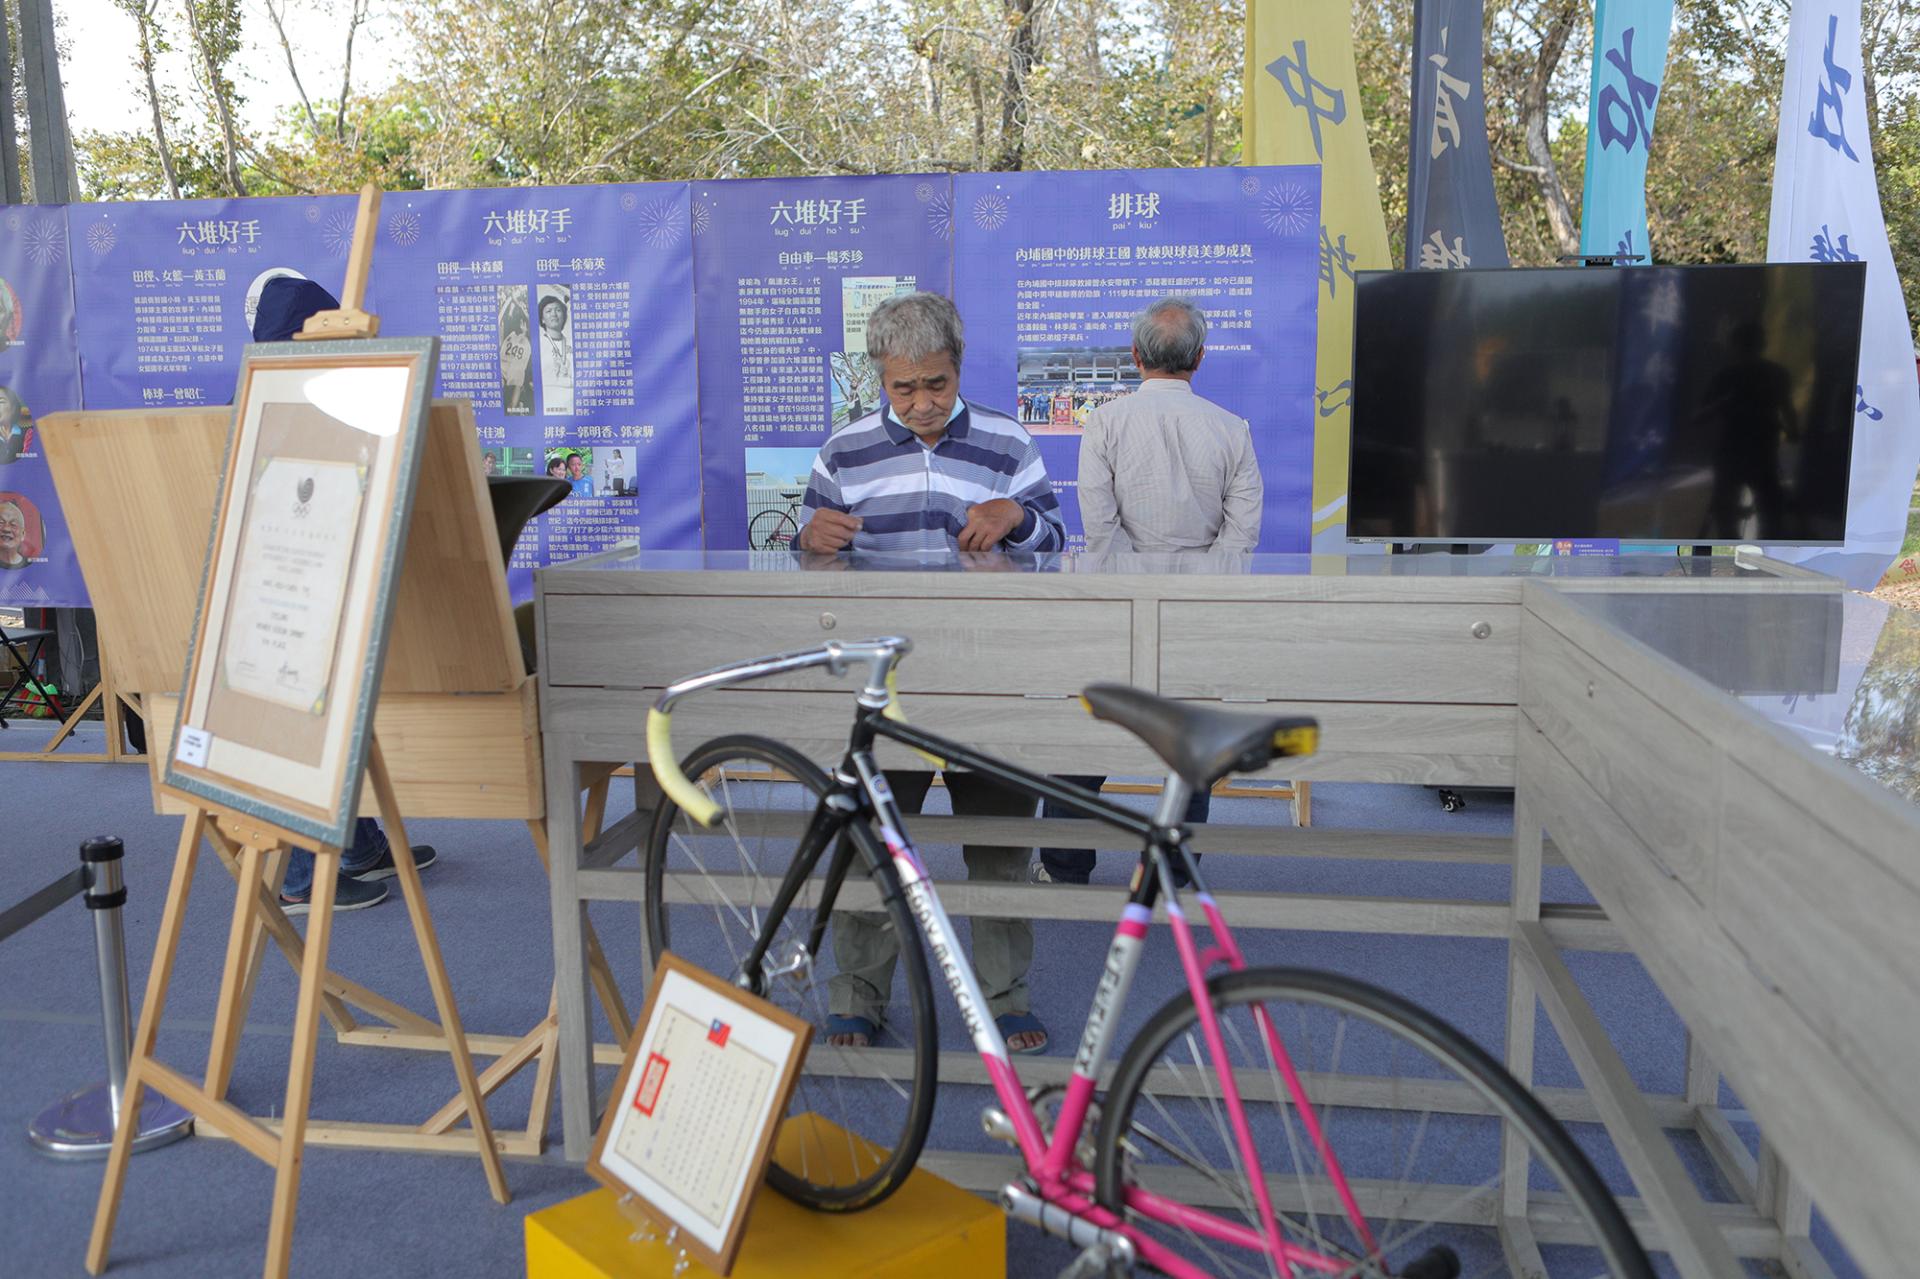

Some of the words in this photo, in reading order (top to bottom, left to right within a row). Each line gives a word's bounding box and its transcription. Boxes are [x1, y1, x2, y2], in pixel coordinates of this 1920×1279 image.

[770, 198, 867, 225] 六堆好手
[1108, 192, 1160, 220] 排球
[177, 219, 262, 245] 六堆好手
[482, 207, 573, 235] 六堆好手
[536, 257, 606, 272] 田徑—徐菊英
[1016, 246, 1131, 261] 內埔國中的排球王國
[1136, 244, 1252, 258] 教練與球員美夢成真
